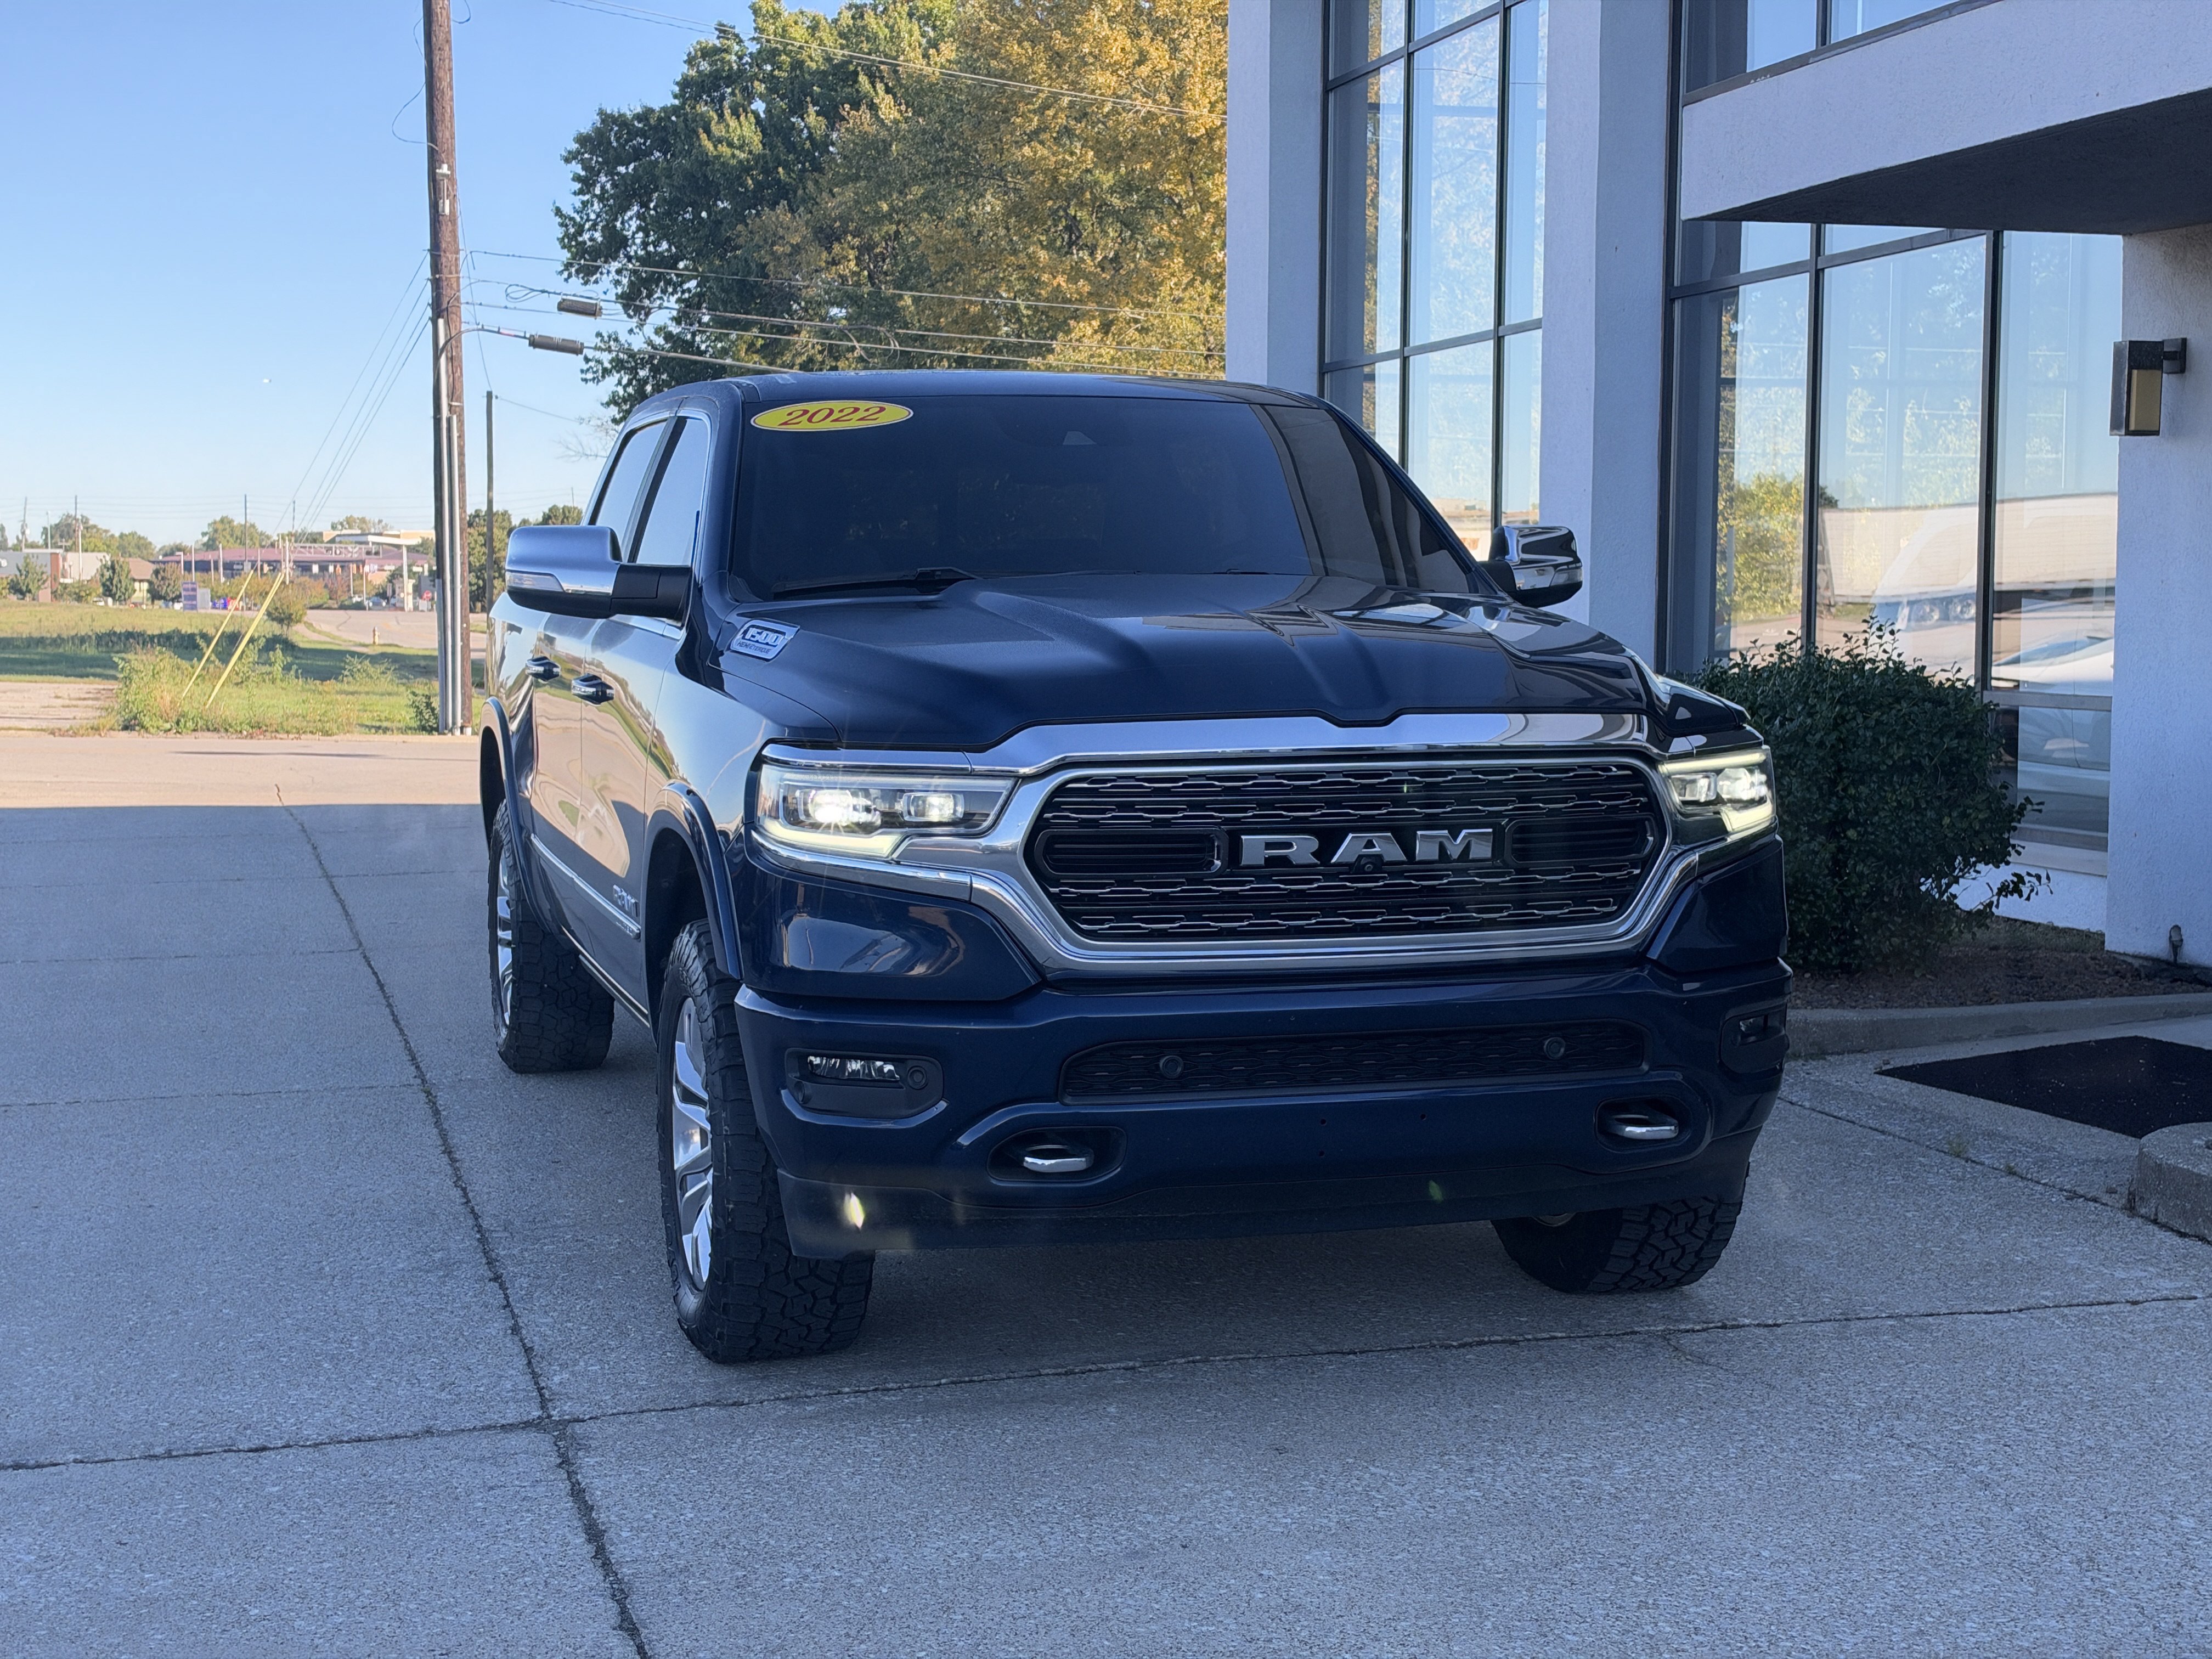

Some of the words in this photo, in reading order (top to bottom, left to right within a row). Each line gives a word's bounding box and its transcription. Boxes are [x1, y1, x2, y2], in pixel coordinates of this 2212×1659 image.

[777, 406, 887, 426] 2022
[745, 628, 785, 646] 1500
[1240, 828, 1493, 866] RAM
